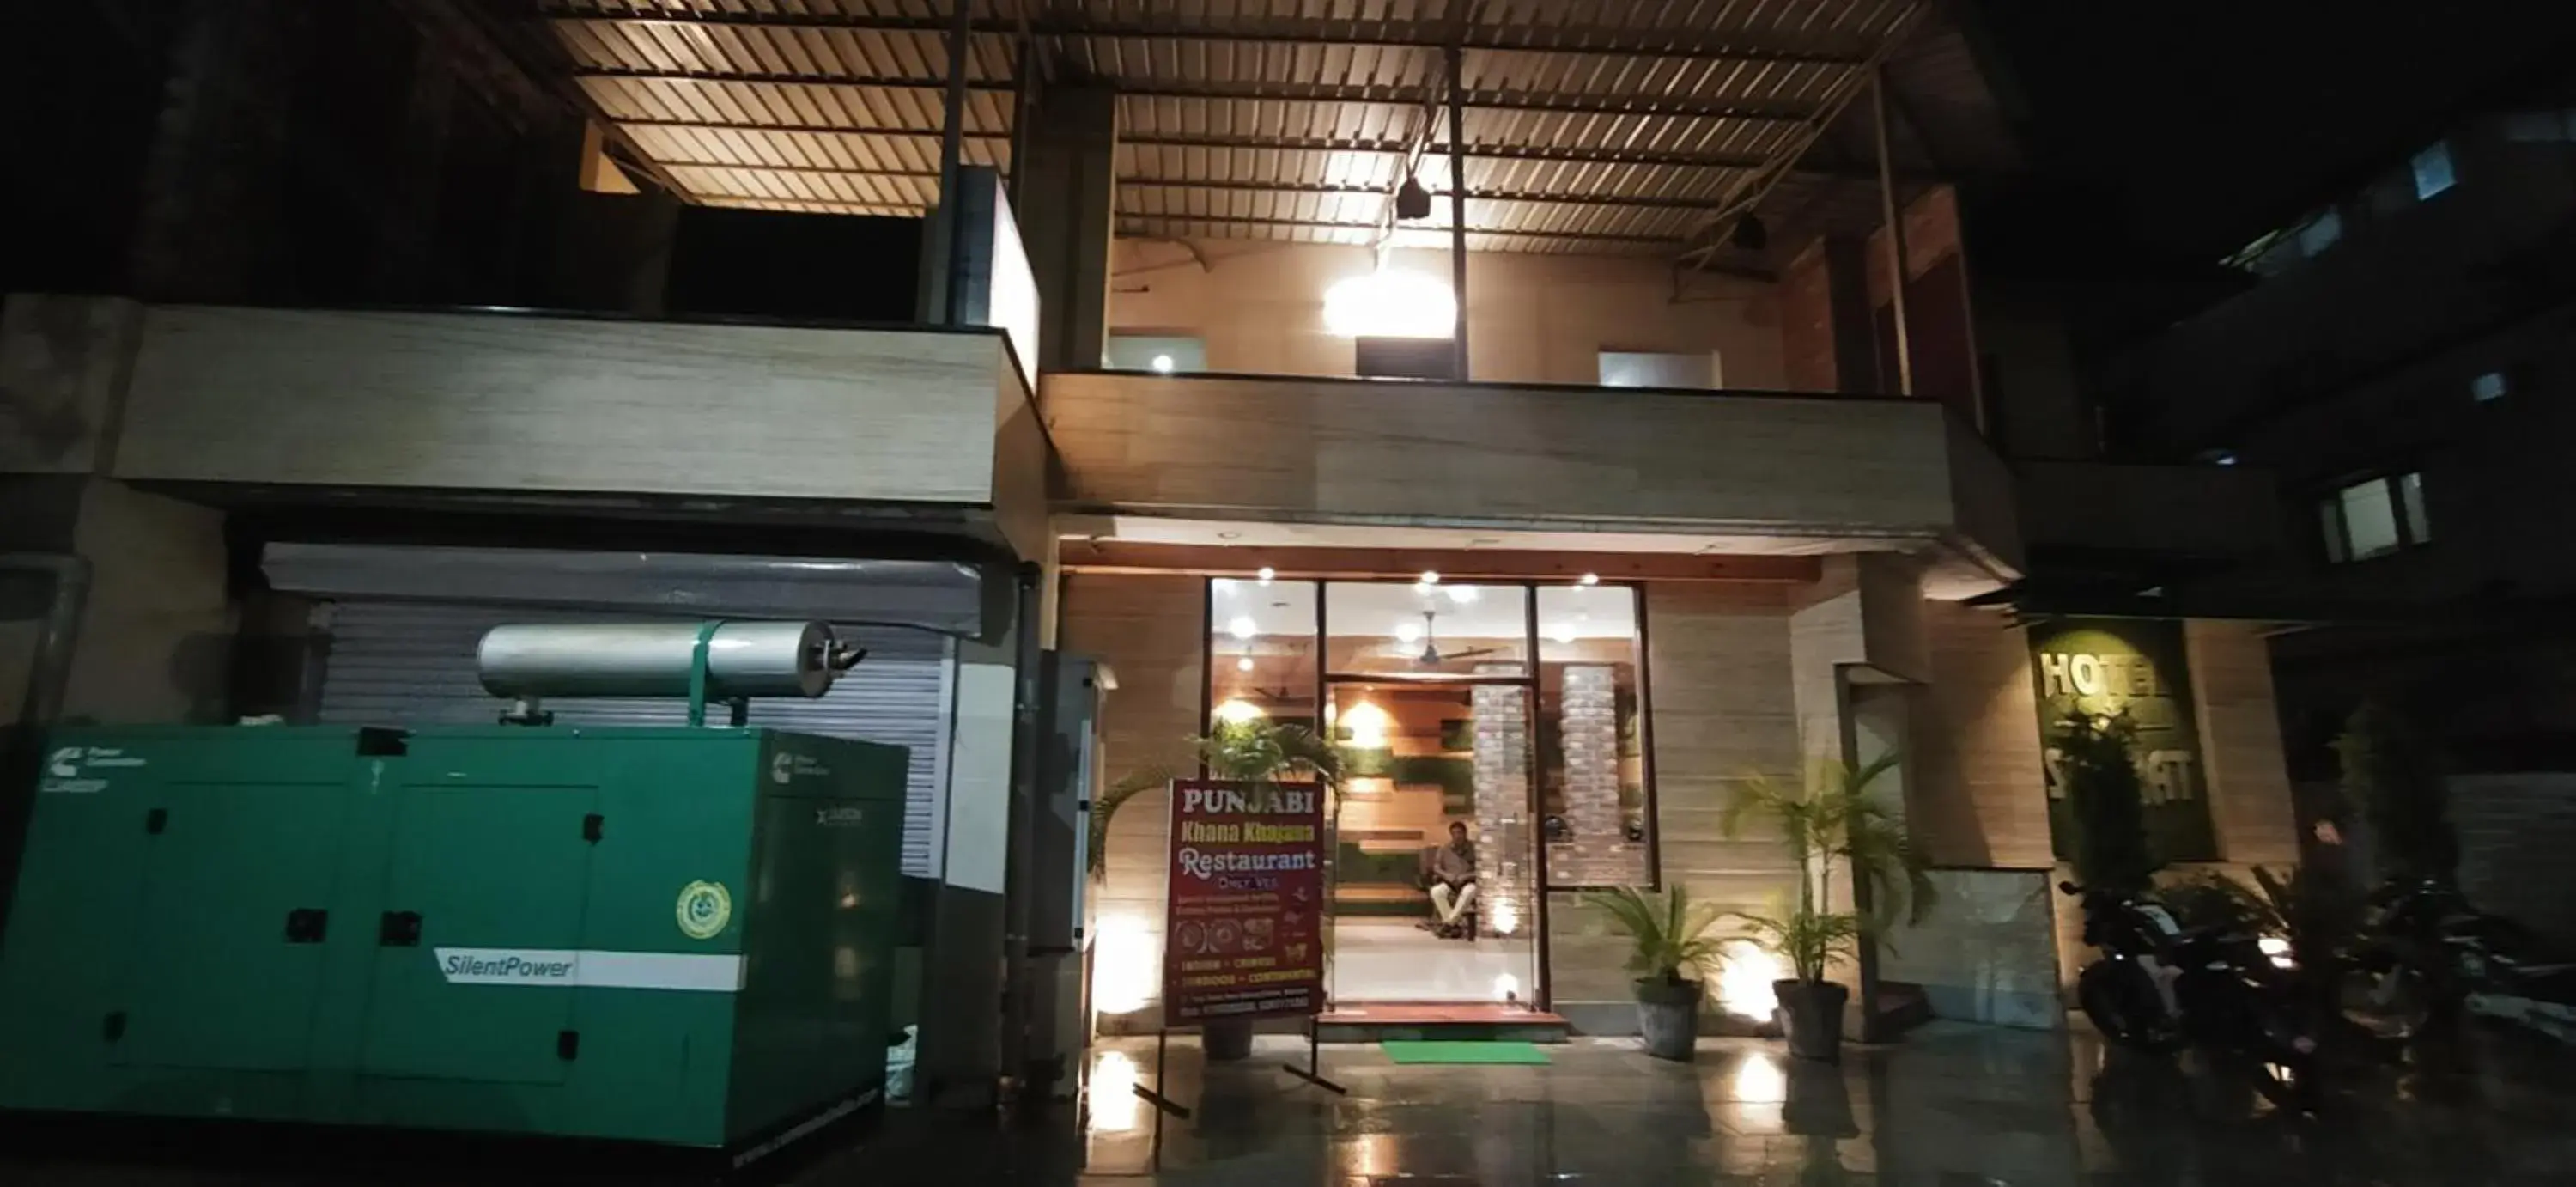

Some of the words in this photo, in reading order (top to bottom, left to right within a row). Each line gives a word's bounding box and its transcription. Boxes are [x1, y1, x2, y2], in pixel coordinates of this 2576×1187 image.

[1182, 788, 1315, 813] PUNJABI
[1181, 821, 1239, 843] Khana
[1178, 847, 1316, 880] Restaurant
[445, 955, 574, 978] SilentPower
